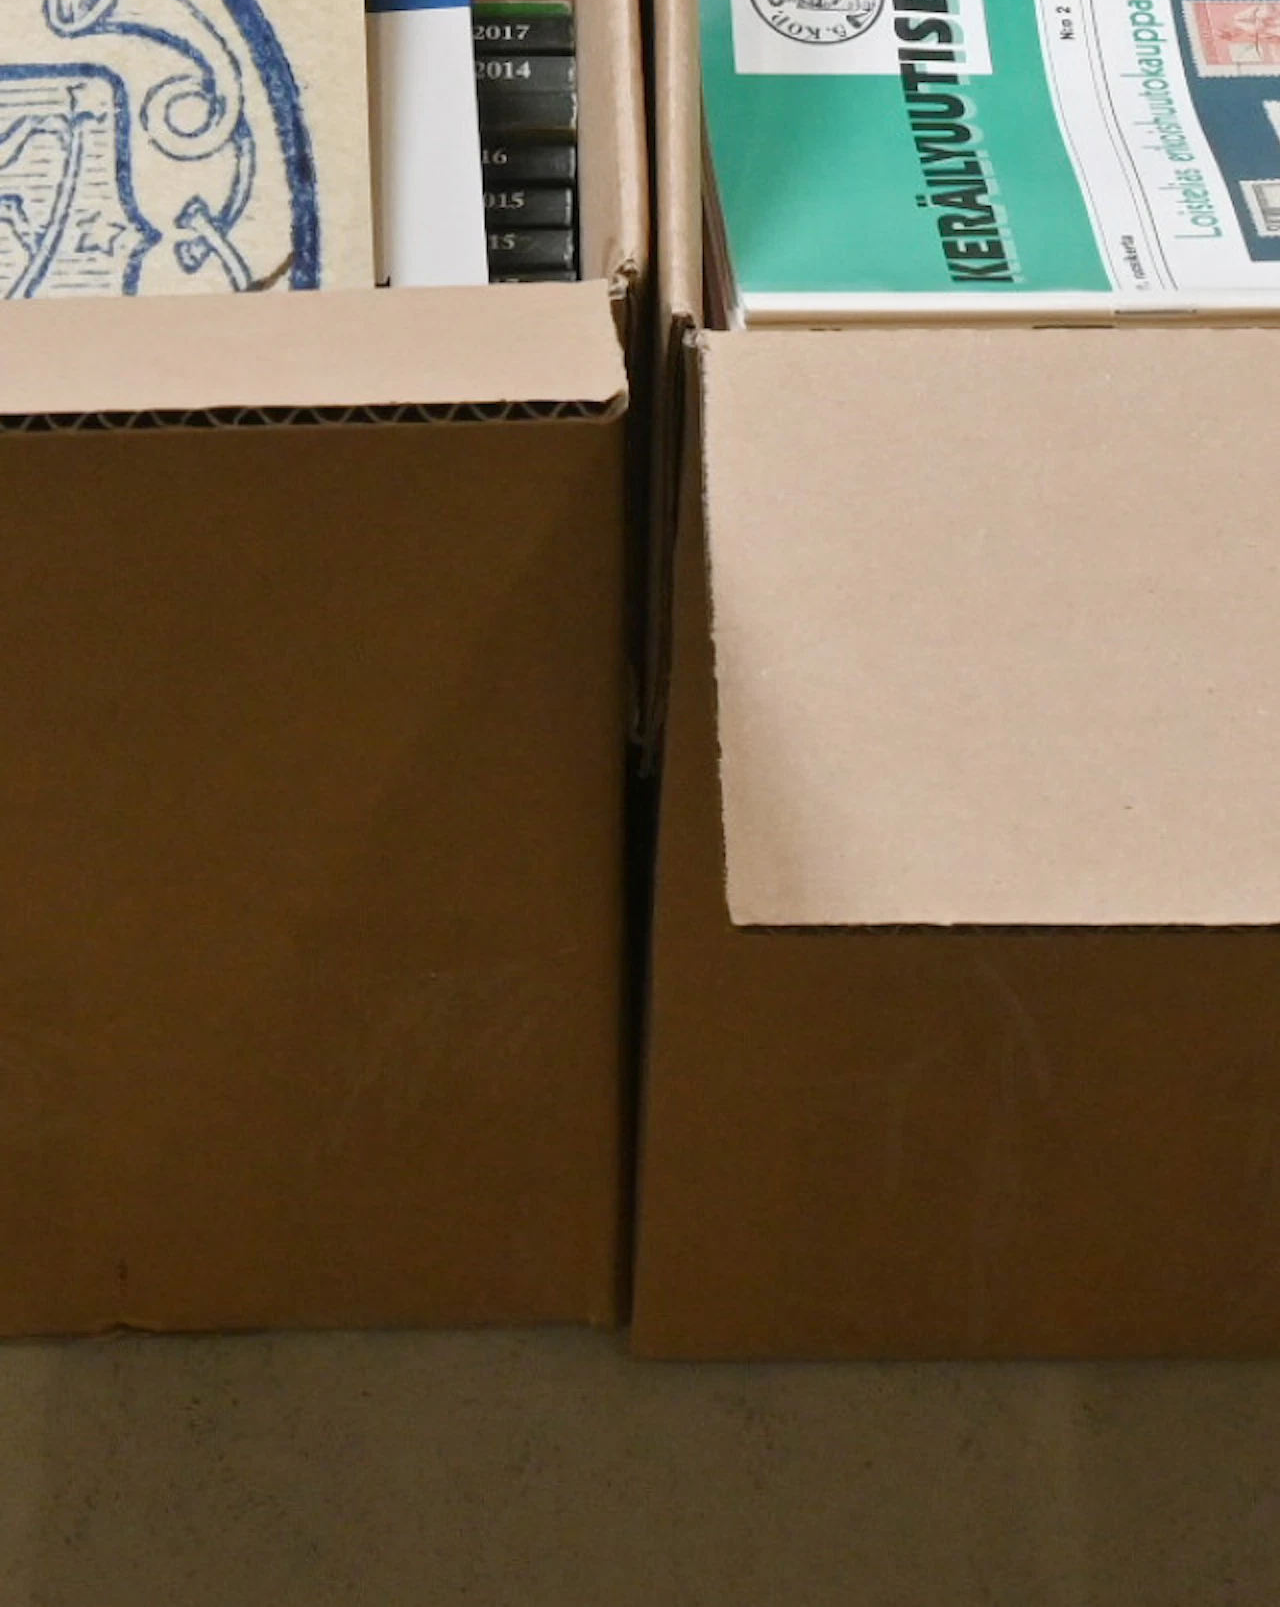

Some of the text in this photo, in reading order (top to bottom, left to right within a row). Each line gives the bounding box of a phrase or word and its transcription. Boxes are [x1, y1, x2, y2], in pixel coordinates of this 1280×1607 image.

[1057, 6, 1071, 14] 2
[474, 25, 530, 41] 2017
[482, 150, 508, 165] 16
[484, 193, 526, 209] 015
[489, 235, 516, 251] 15
